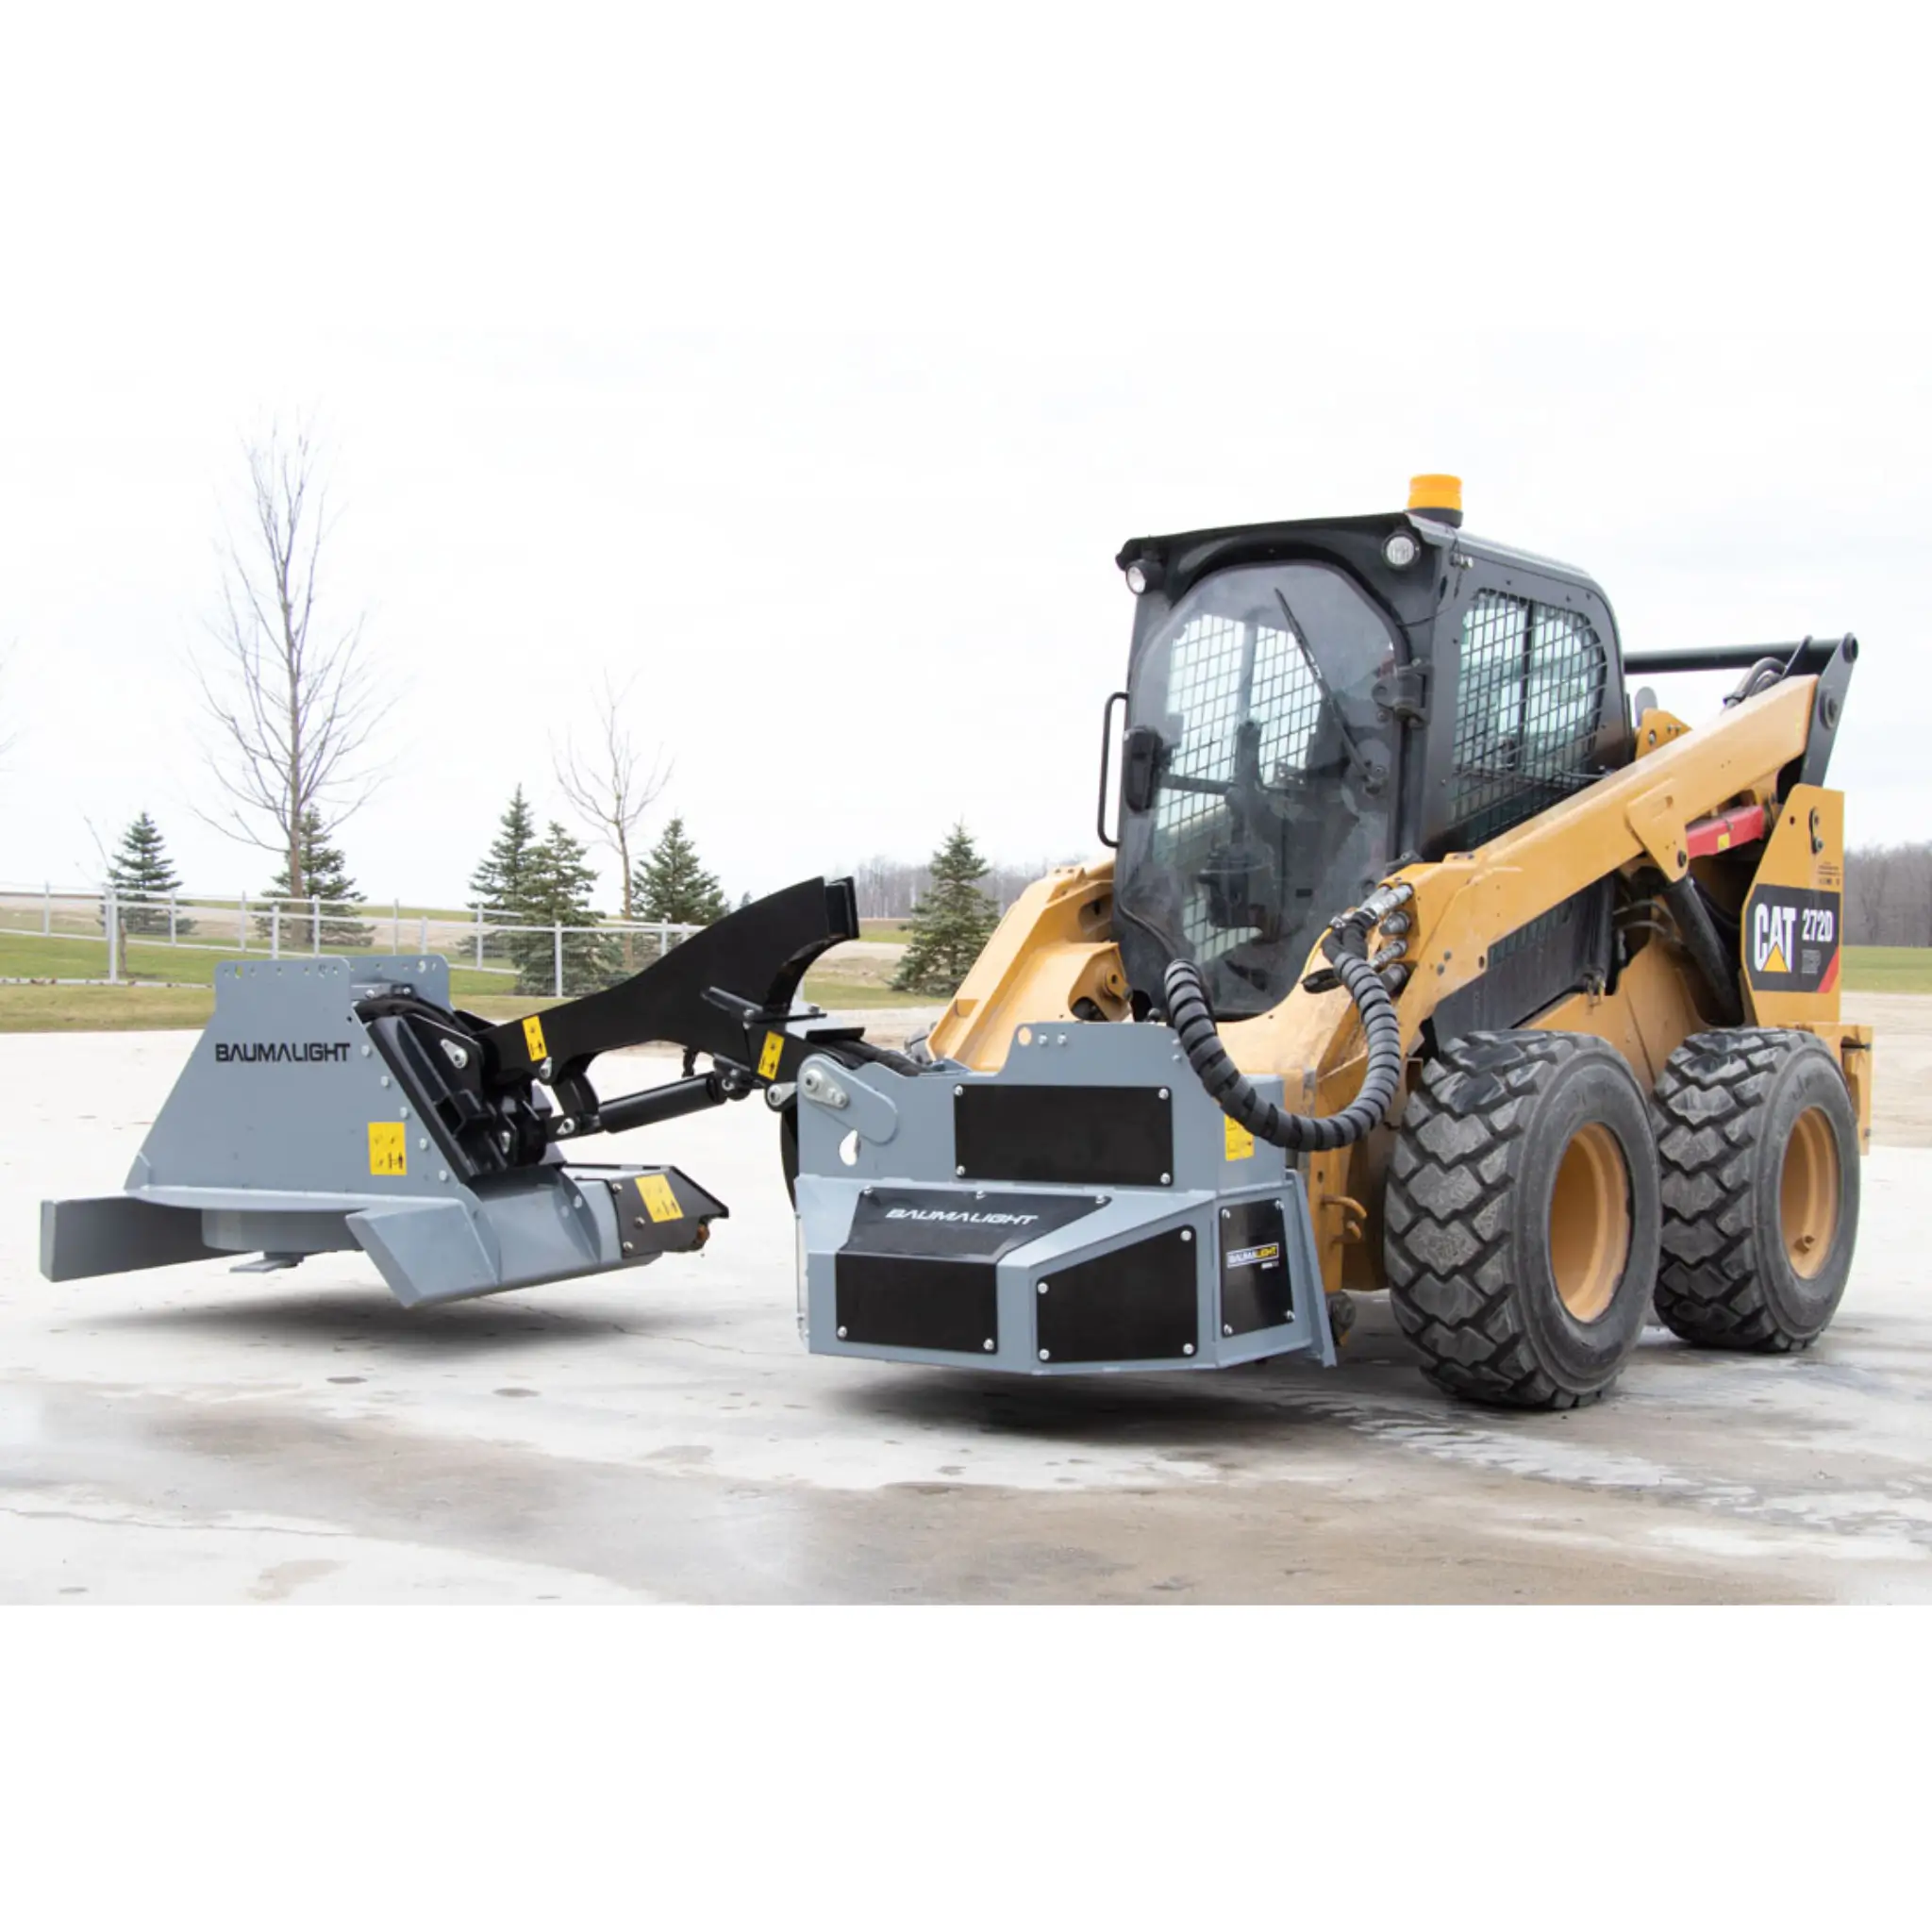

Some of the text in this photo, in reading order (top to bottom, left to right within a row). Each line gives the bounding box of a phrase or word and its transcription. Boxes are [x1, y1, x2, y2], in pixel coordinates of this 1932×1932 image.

[1755, 904, 1796, 973] CAT
[1802, 908, 1834, 941] 272D
[215, 1042, 351, 1062] BAUMALIGHT
[885, 1208, 1038, 1224] BAUMALIGHT
